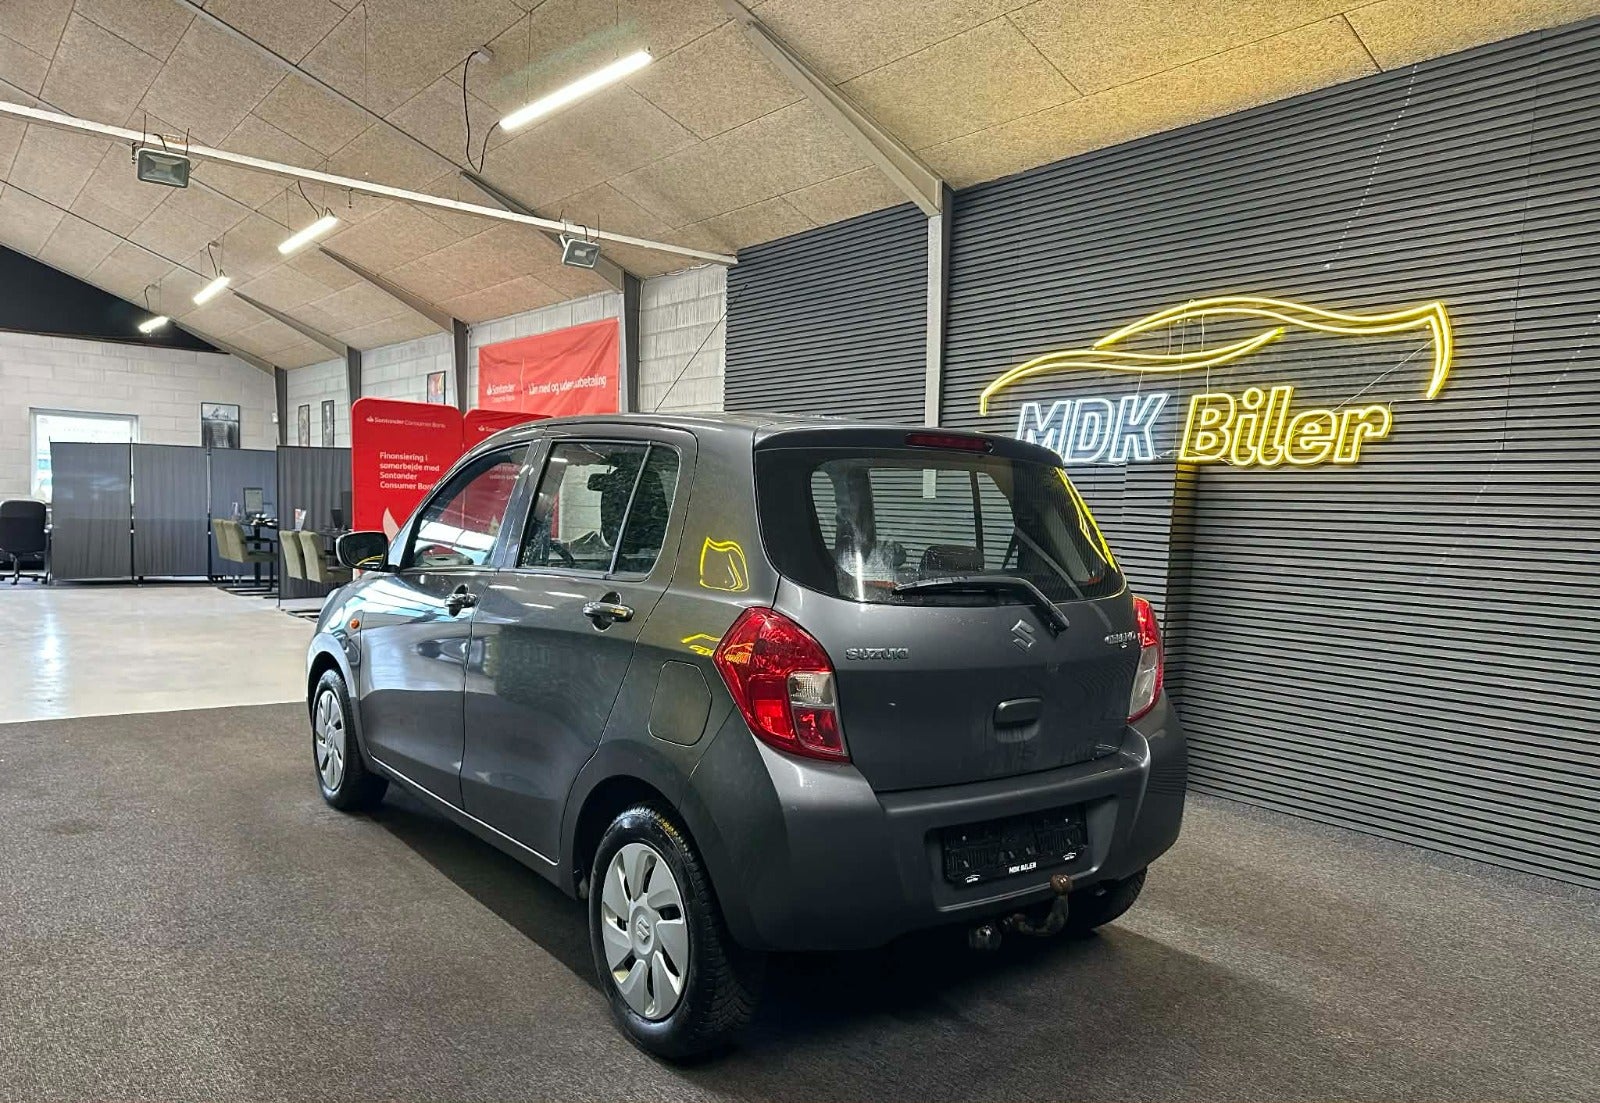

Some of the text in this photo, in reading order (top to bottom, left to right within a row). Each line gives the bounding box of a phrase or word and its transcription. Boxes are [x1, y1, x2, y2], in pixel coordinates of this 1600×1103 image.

[551, 382, 560, 395] og
[374, 416, 404, 425] Santander
[404, 419, 432, 427] Consumer
[1016, 385, 1392, 466] MDK Biler
[379, 451, 428, 463] Finansiering i
[379, 462, 440, 472] samarbejde med
[379, 471, 418, 480] Santander
[379, 481, 417, 490] Consumer
[845, 647, 909, 661] SUZUKI
